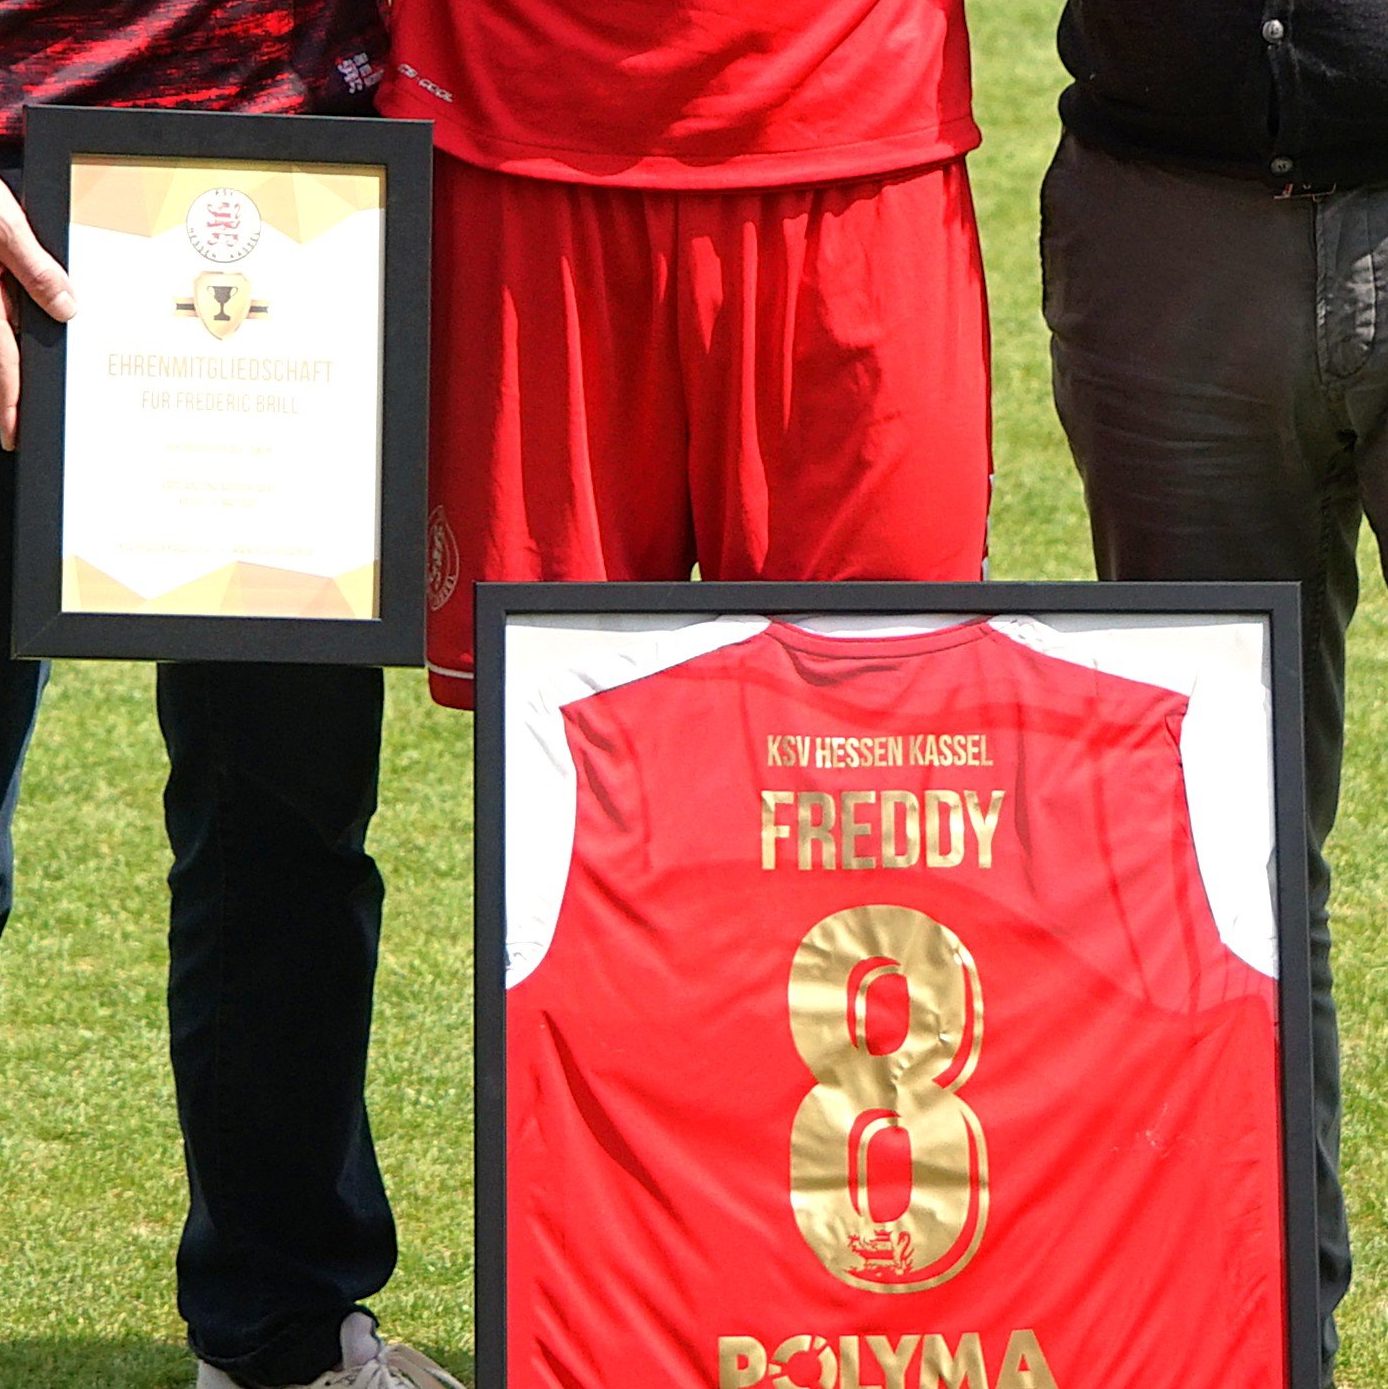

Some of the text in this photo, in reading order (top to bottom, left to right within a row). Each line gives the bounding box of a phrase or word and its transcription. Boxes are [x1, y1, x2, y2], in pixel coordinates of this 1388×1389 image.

[107, 352, 334, 384] EHRENMITGLIEDSCHAFT
[175, 391, 251, 413] FREDERIC
[255, 394, 300, 415] BRILL
[767, 733, 994, 769] KSV HESSEN KASSEL
[761, 789, 1007, 871] FREDDY
[787, 904, 990, 1295] 8
[717, 1328, 1060, 1389] POLYMA
